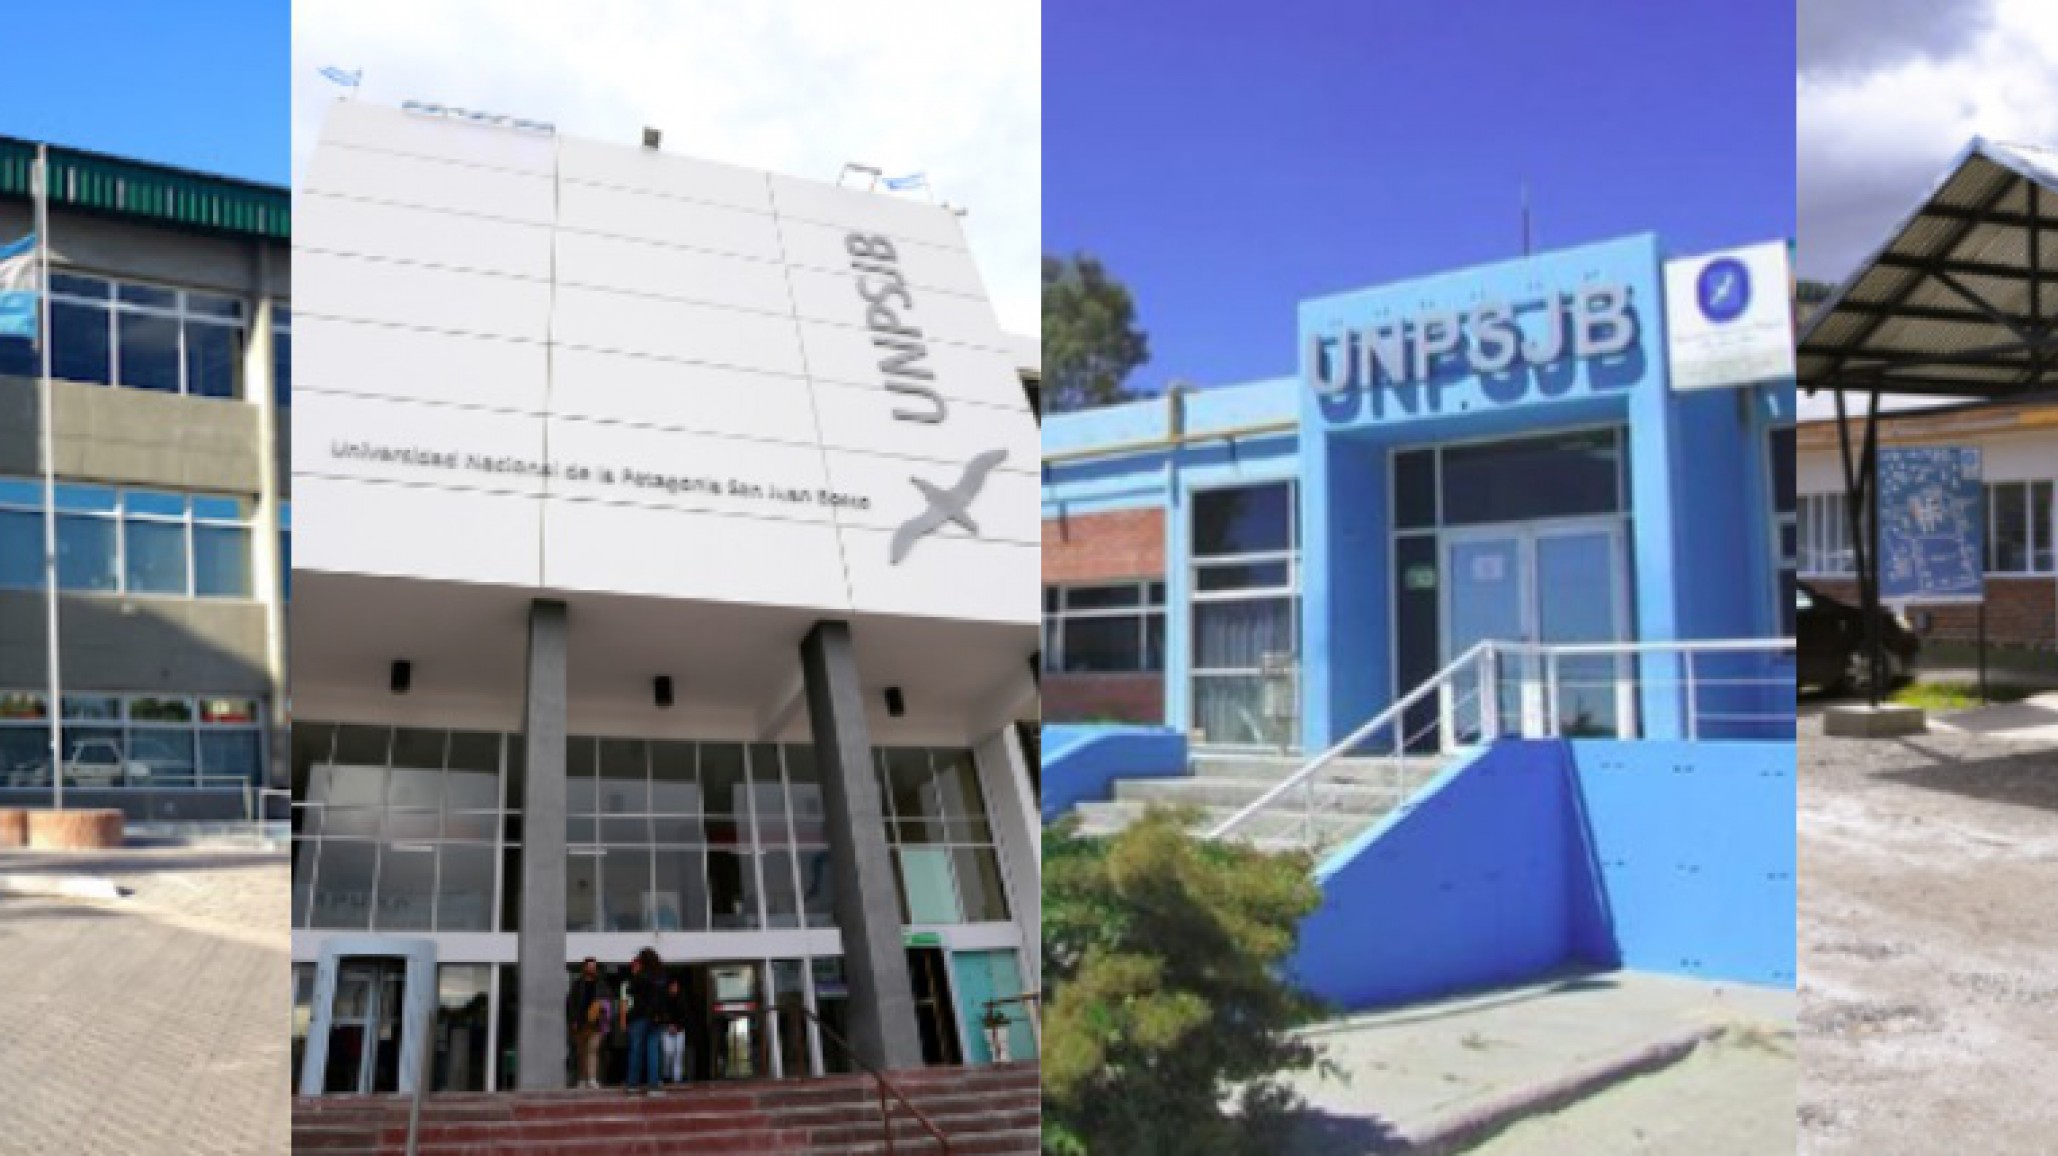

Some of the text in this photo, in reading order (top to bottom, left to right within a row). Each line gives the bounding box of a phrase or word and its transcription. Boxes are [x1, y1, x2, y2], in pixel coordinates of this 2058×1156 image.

[845, 233, 947, 425] UNPSJB
[1308, 282, 1634, 395] UNPSJB
[331, 439, 871, 510] Universidad Nacional de la Patagonia San Juan Bosco
